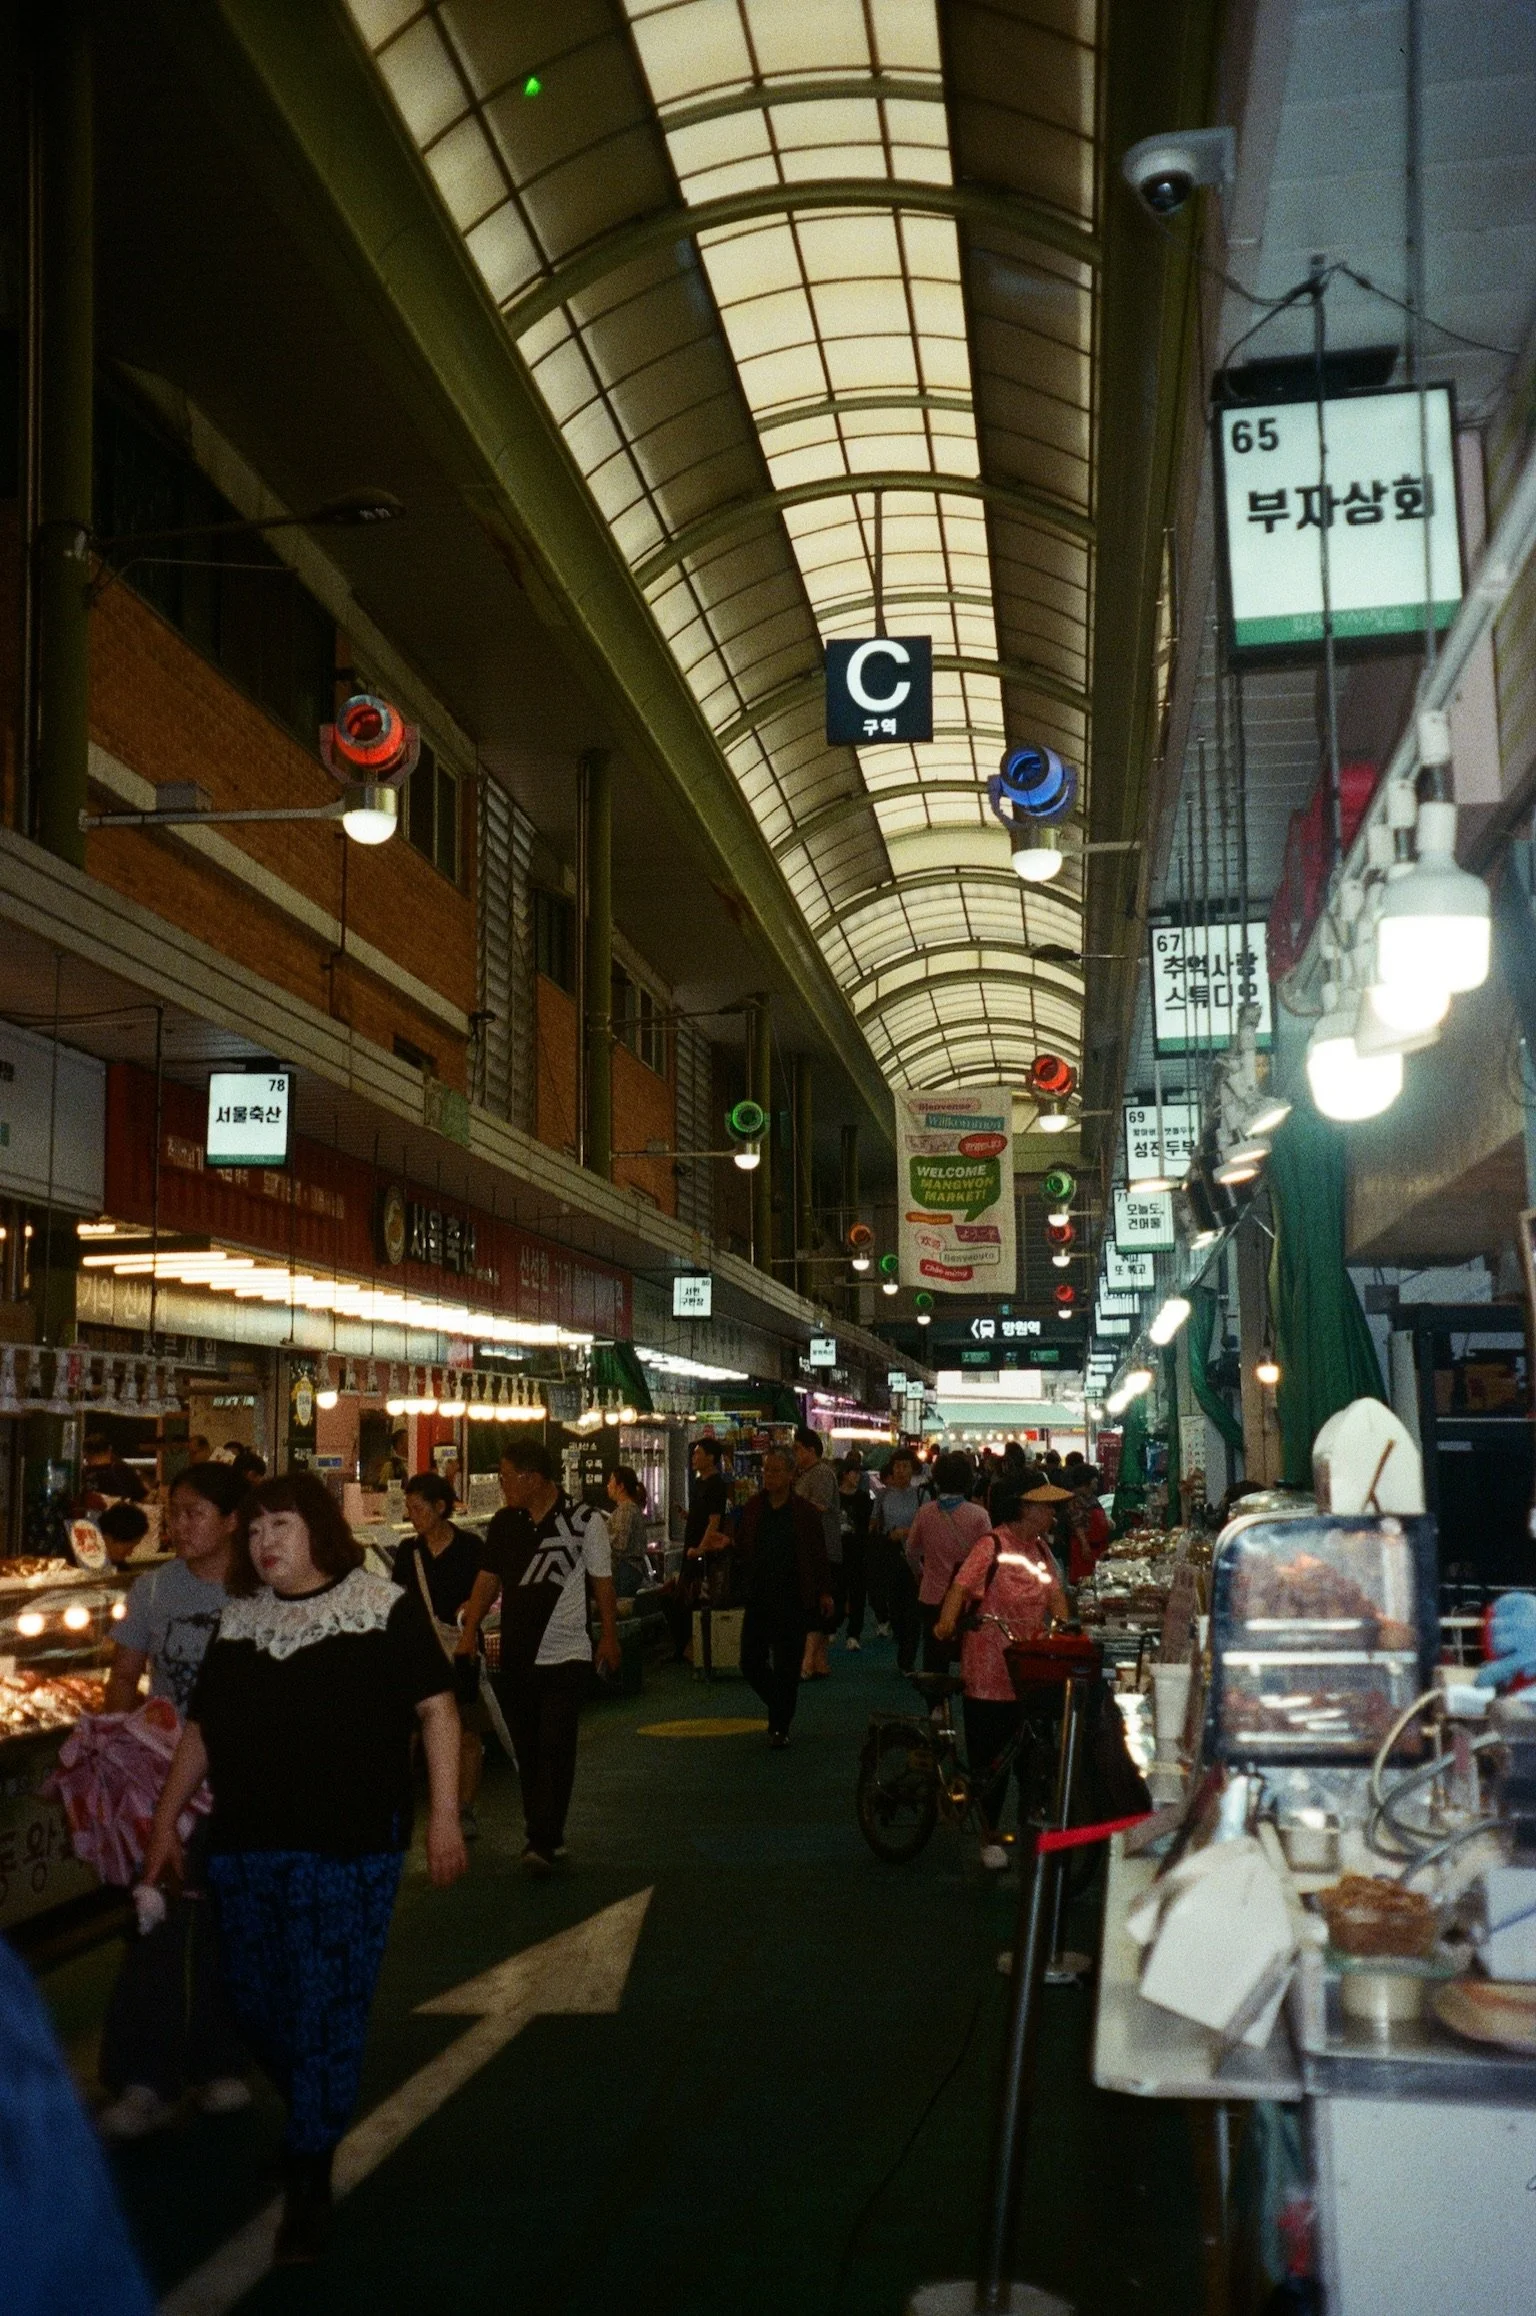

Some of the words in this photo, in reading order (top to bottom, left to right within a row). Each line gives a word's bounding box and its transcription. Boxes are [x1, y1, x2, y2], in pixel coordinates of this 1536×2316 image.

[1231, 417, 1279, 453] 65
[1246, 472, 1435, 533] 부자상회
[846, 640, 911, 712] C
[862, 718, 897, 736] 구역
[1157, 934, 1180, 953] 67
[1165, 983, 1260, 1010] 스튜디오
[269, 1079, 285, 1092] 78
[216, 1105, 282, 1123] 서울축산
[1128, 1111, 1145, 1123] 69
[916, 1165, 987, 1179] WELCOME
[920, 1177, 995, 1190] MANGWON
[924, 1189, 986, 1201] MARKET!
[1001, 1321, 1041, 1337] 망원역
